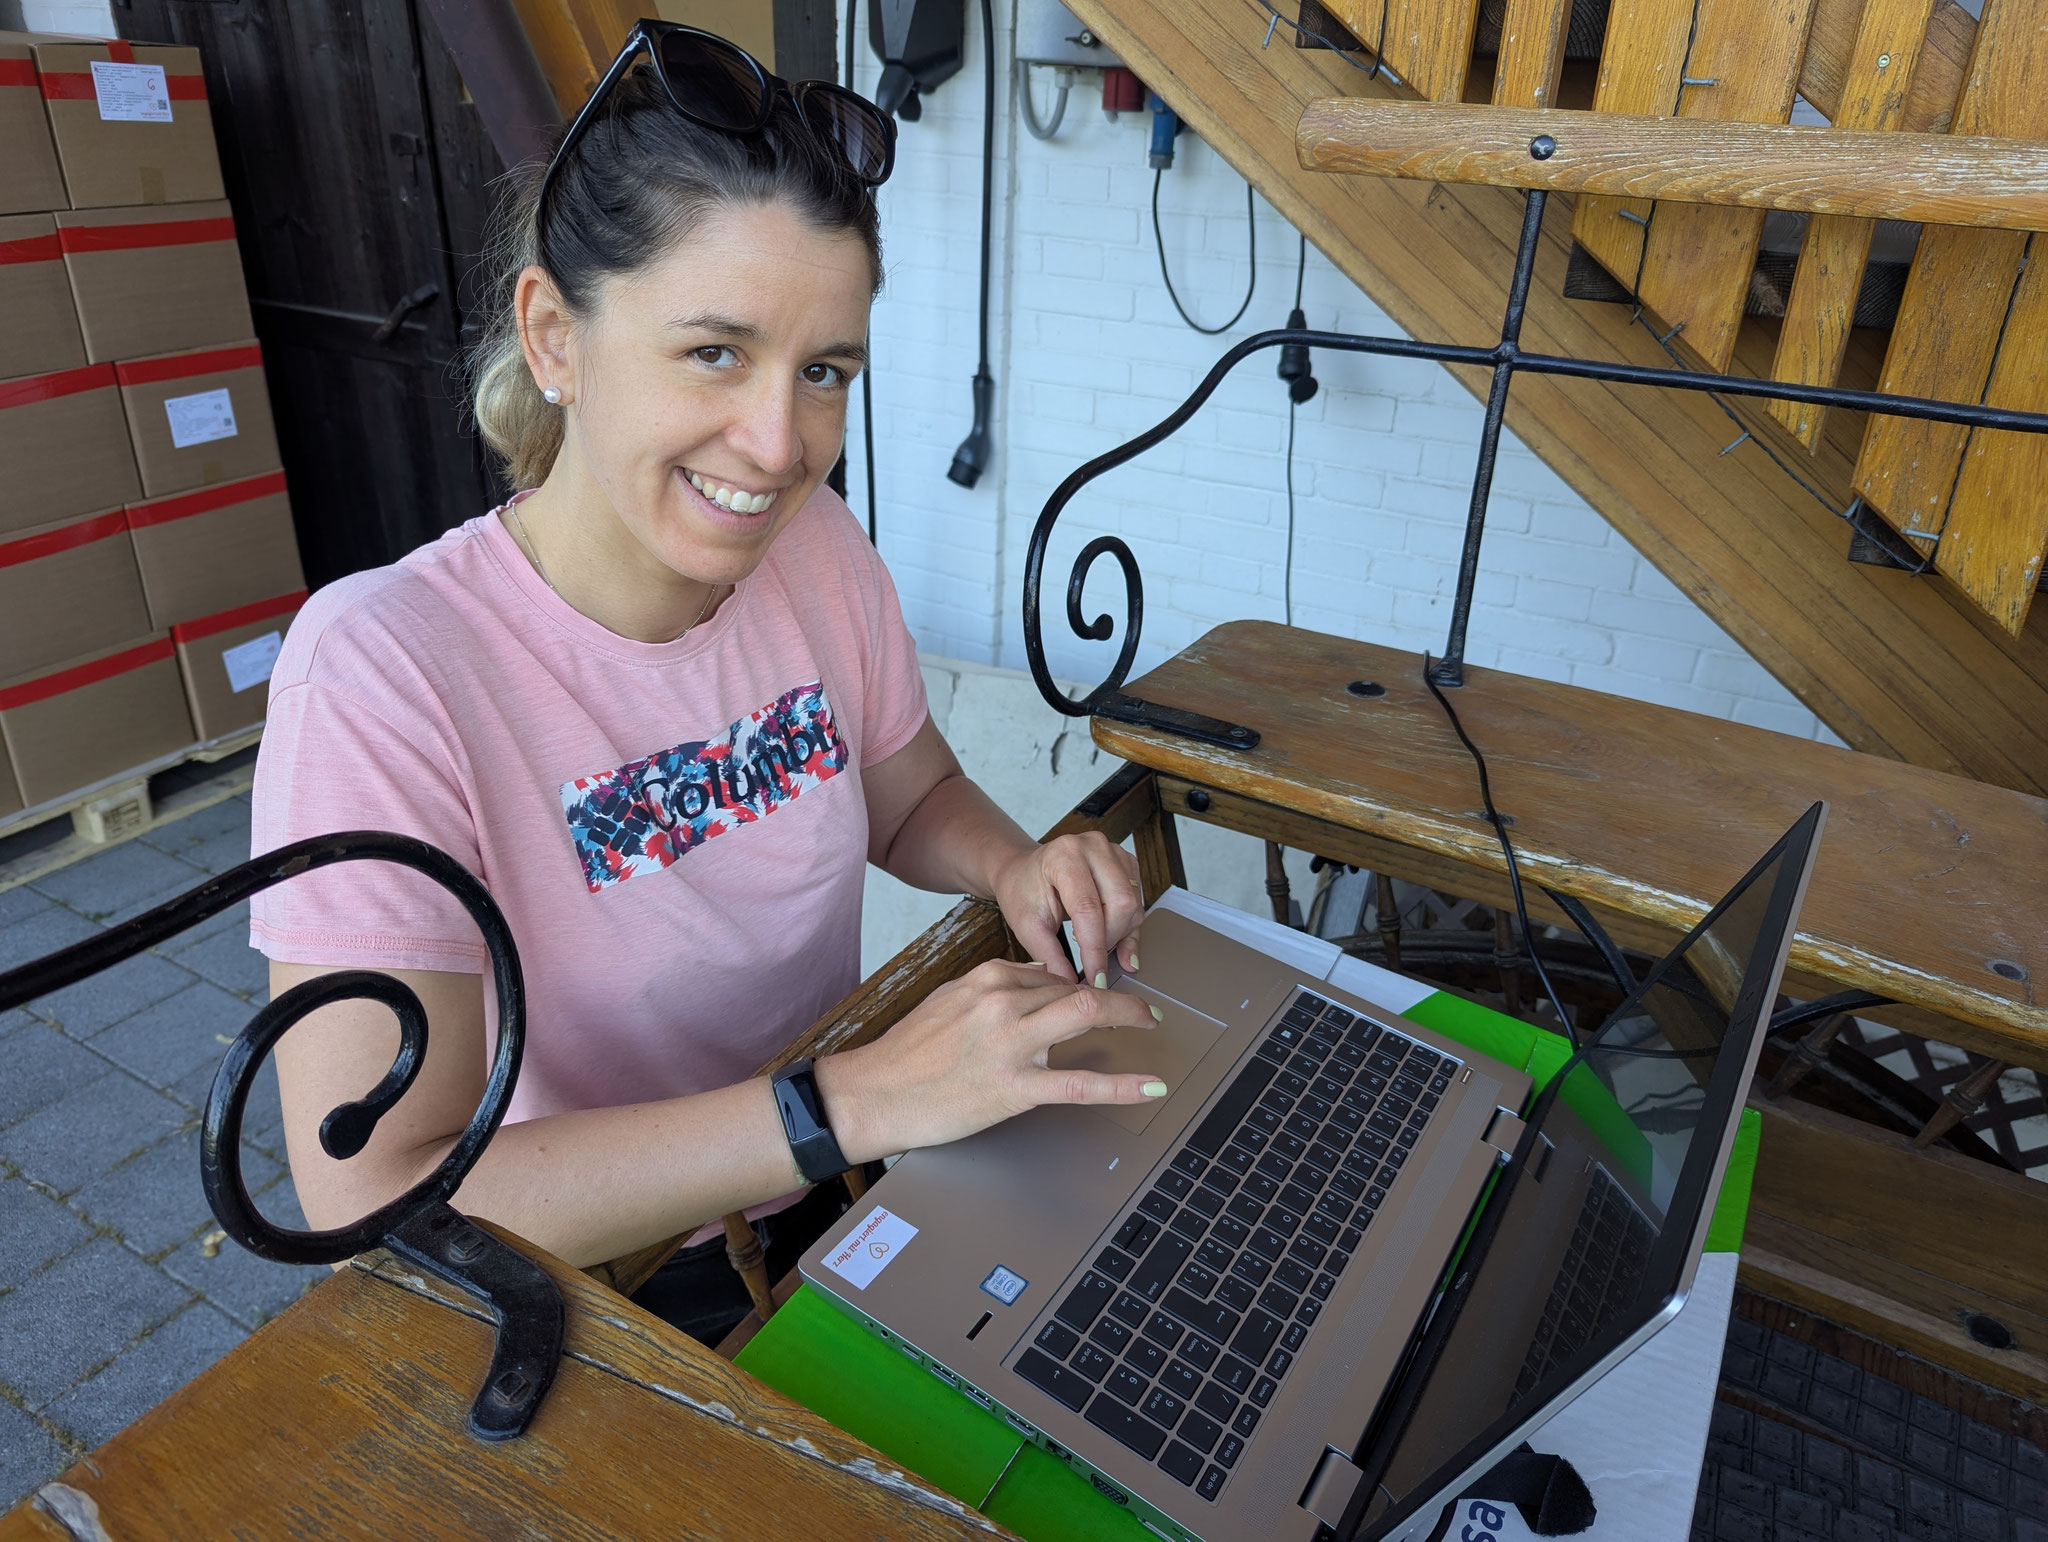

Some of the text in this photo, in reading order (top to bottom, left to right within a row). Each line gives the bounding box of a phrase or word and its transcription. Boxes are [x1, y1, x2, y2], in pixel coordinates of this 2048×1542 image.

[832, 1211, 889, 1268] engagiert mit Herz
[1082, 1274, 1093, 1288] insert
[1147, 1281, 1159, 1296] pause
[1121, 1296, 1129, 1307] end
[1041, 1324, 1055, 1341] delete
[1186, 1338, 1199, 1352] home
[1273, 1355, 1285, 1370] delete
[1258, 1382, 1270, 1398] home
[1242, 1414, 1252, 1426] end
[1228, 1441, 1236, 1450] pg
[1210, 1472, 1218, 1482] pg
